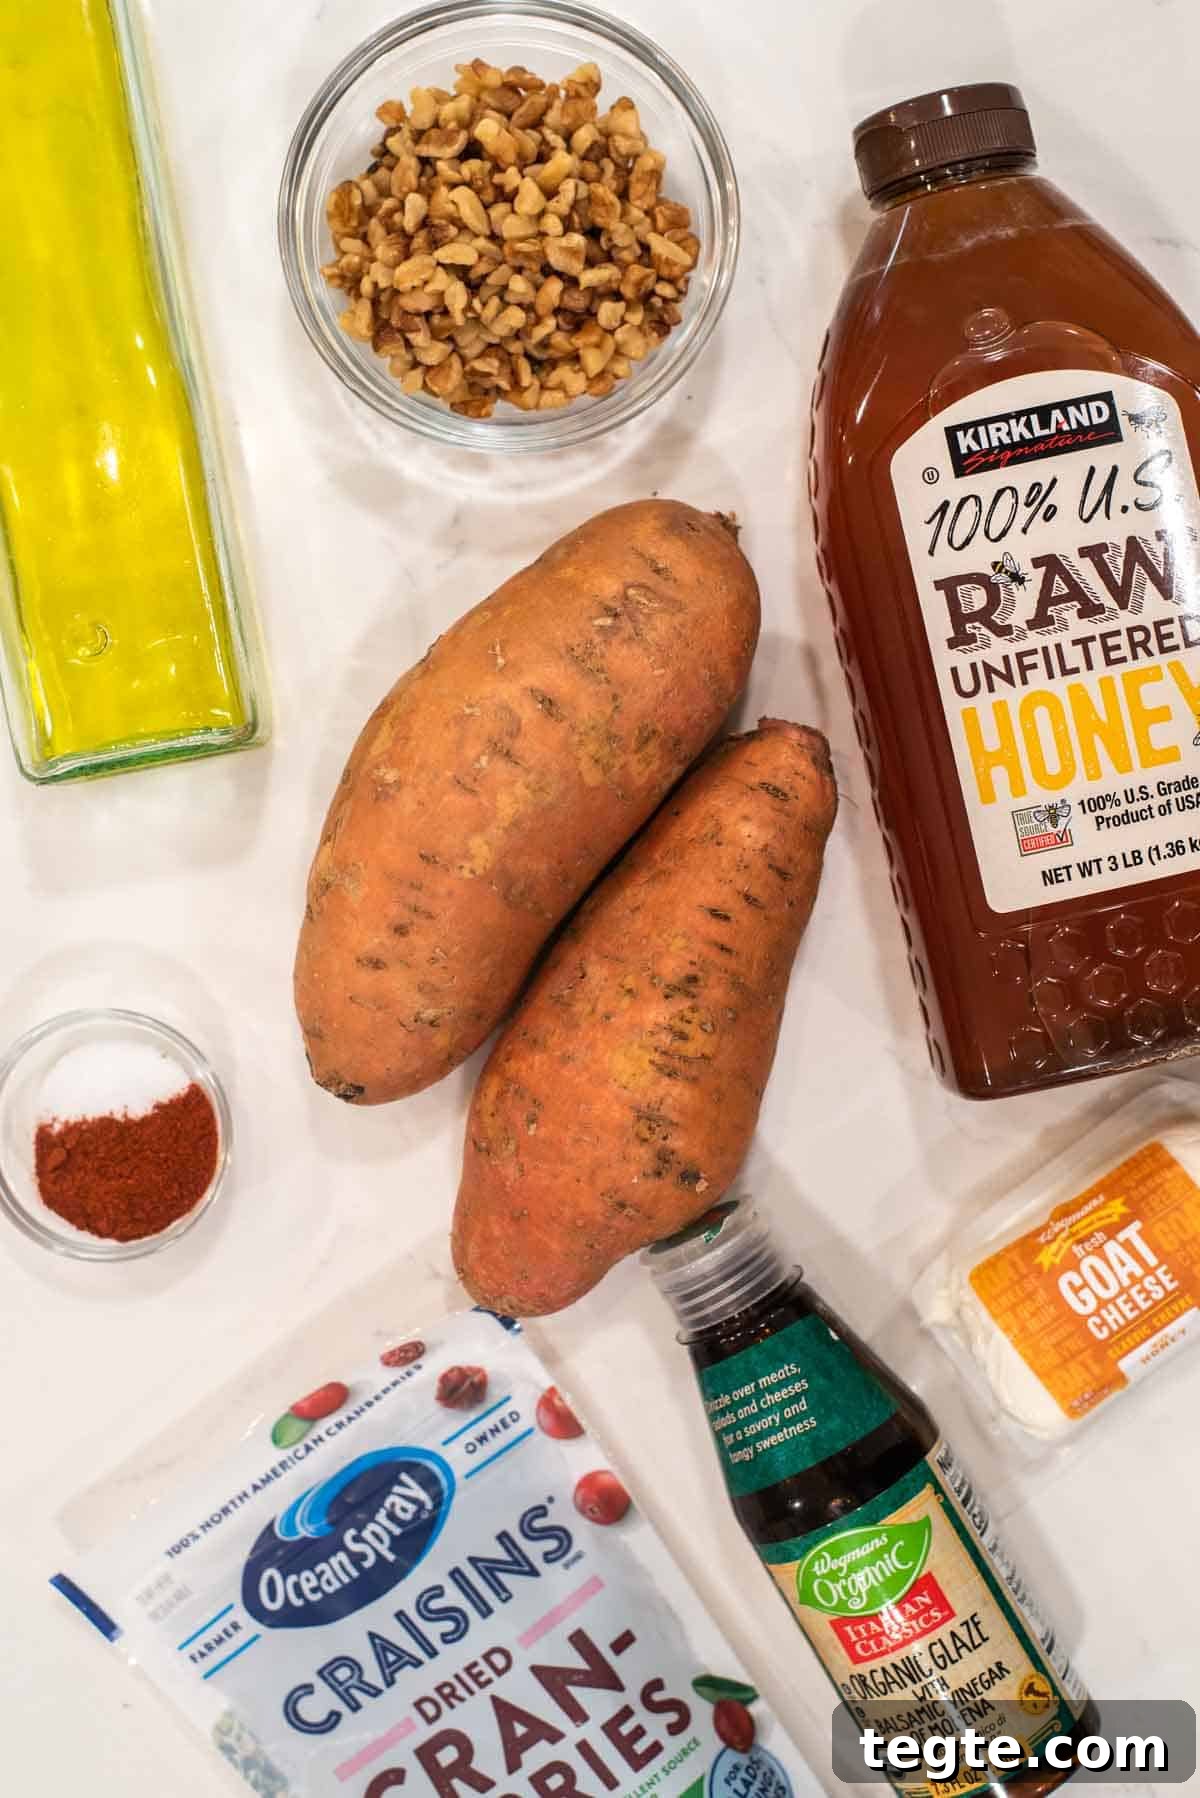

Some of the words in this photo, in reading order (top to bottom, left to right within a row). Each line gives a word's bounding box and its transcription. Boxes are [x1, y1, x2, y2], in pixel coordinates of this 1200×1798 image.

[955, 400, 1112, 453] KIRKLAND
[962, 430, 1115, 475] Signature
[924, 477, 1058, 556] 100%
[933, 528, 1196, 654] RAW
[949, 614, 1200, 699] UNFILTERED
[1077, 791, 1122, 815] 100%
[1123, 784, 1154, 805] U.S.
[1156, 775, 1200, 797] Grade
[1094, 804, 1155, 832] Product
[1157, 799, 1173, 817] of
[1040, 864, 1074, 887] NET
[1076, 857, 1103, 879] WT
[1107, 855, 1119, 872] 3
[1122, 849, 1143, 869] LB
[1147, 838, 1186, 867] (1.36
[1188, 836, 1200, 853] k
[1057, 1219, 1159, 1316] GOAT
[1072, 1231, 1107, 1258] fresh
[1087, 1264, 1179, 1341] CHEESE
[732, 1381, 756, 1401] over
[758, 1362, 801, 1390] meats,
[737, 1399, 759, 1420] and
[760, 1378, 809, 1409] cheeses
[463, 1409, 522, 1457] OWNED
[735, 1430, 743, 1441] a
[743, 1411, 781, 1438] savory
[783, 1395, 809, 1419] and
[755, 1415, 817, 1453] sweetness
[199, 1490, 250, 1533] NORTH
[250, 1434, 326, 1497] AMERICAN
[259, 1550, 359, 1613] Ocean
[342, 1470, 434, 1571] Spray
[812, 1532, 888, 1577] Wegmans
[812, 1540, 915, 1610] Organic
[189, 1620, 243, 1664] FARMER
[283, 1503, 573, 1735] CRAISINS
[853, 1607, 944, 1658] CLASSICS
[849, 1648, 933, 1702] ORGANIC
[928, 1612, 990, 1671] GLAZE
[412, 1646, 513, 1726] DRIED
[873, 1700, 946, 1735] BALSAMIC
[949, 1660, 1012, 1708] VINEGAR
[911, 1675, 950, 1704] WITH
[502, 1676, 692, 1798] RIES
[660, 1735, 702, 1776] SOURCE
[723, 1761, 742, 1788] FOR
[733, 1755, 762, 1798] LADS
